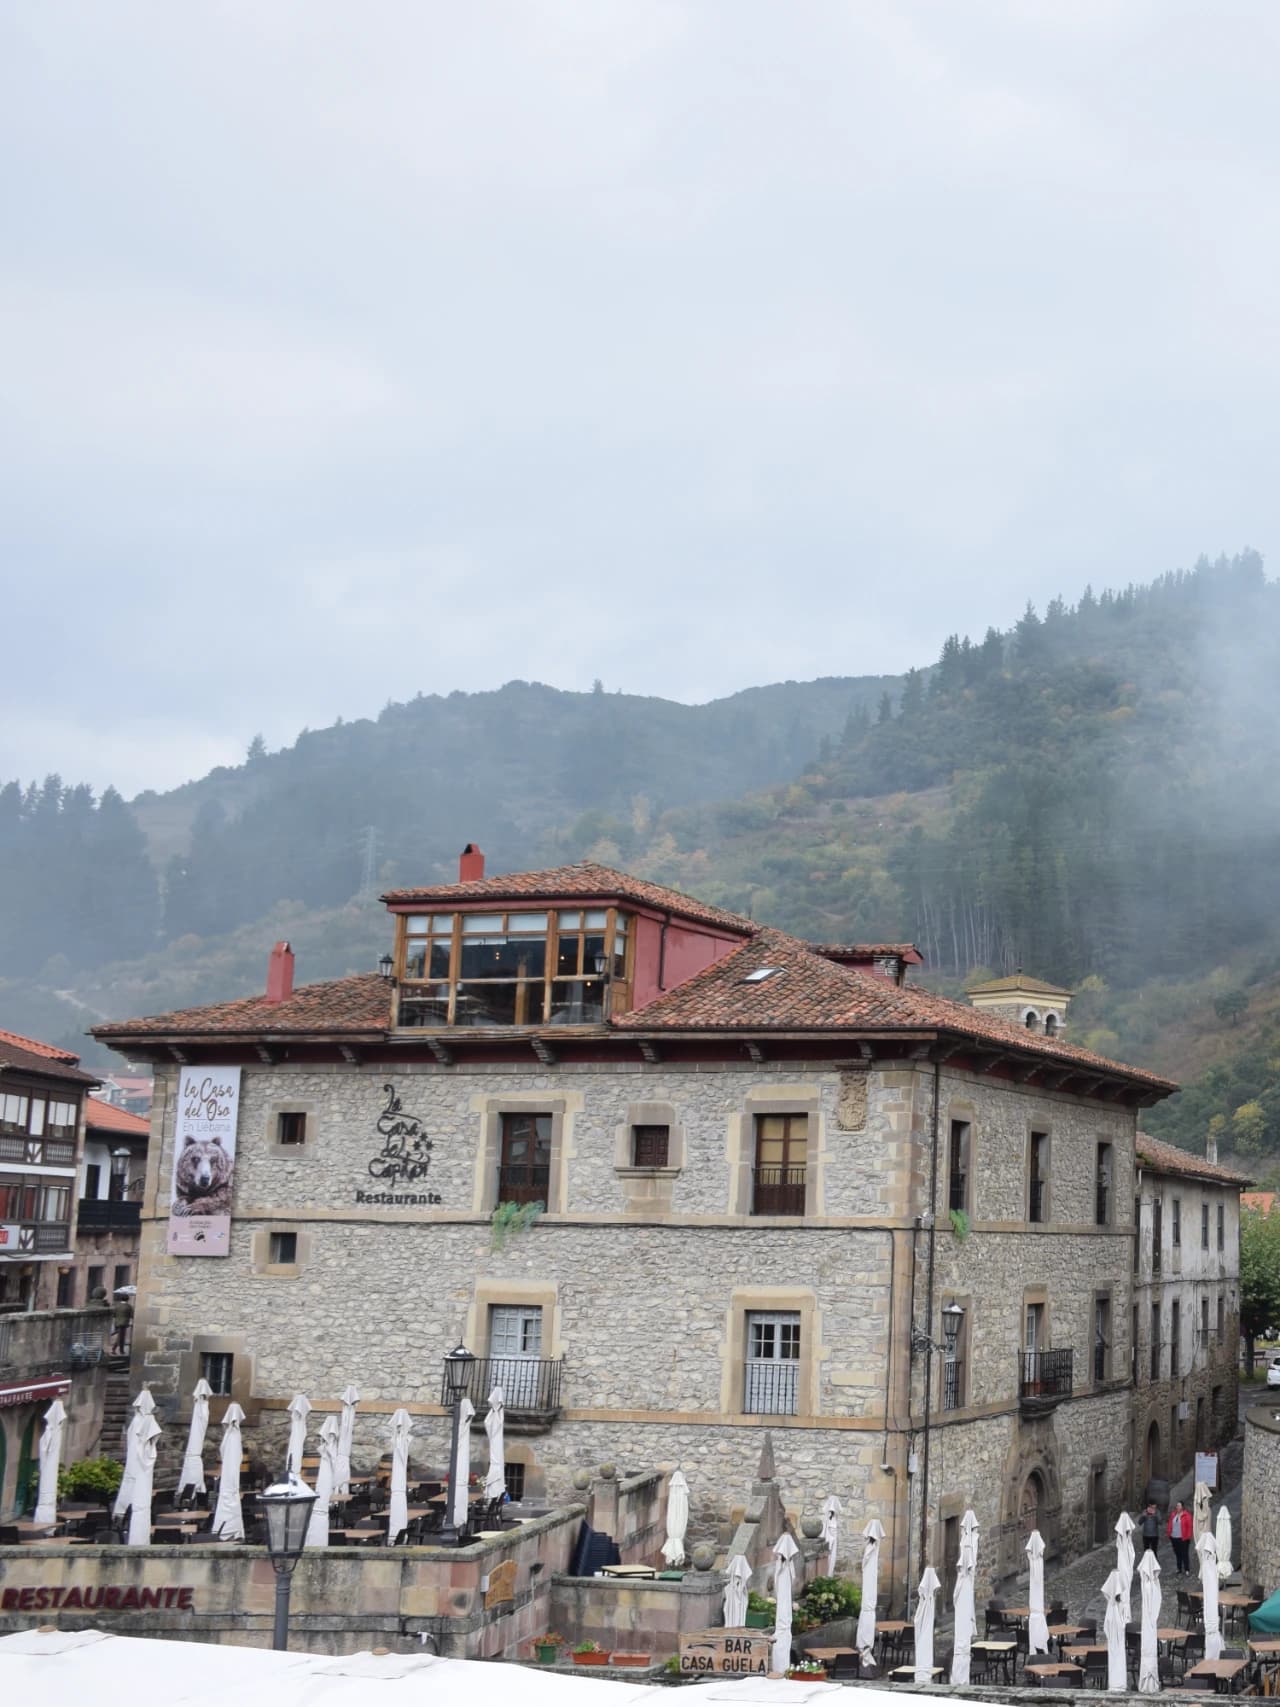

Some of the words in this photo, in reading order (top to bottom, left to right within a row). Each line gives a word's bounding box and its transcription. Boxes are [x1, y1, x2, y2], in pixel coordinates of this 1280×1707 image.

[200, 1077, 235, 1103] Casa
[184, 1099, 202, 1119] del
[206, 1098, 231, 1121] Oso
[183, 1121, 195, 1132] En
[376, 1115, 420, 1137] Casa
[355, 1190, 442, 1206] Restaurante
[1, 1586, 195, 1610] RESTAURANTE
[725, 1639, 752, 1655] BAR
[681, 1656, 714, 1671] CASA
